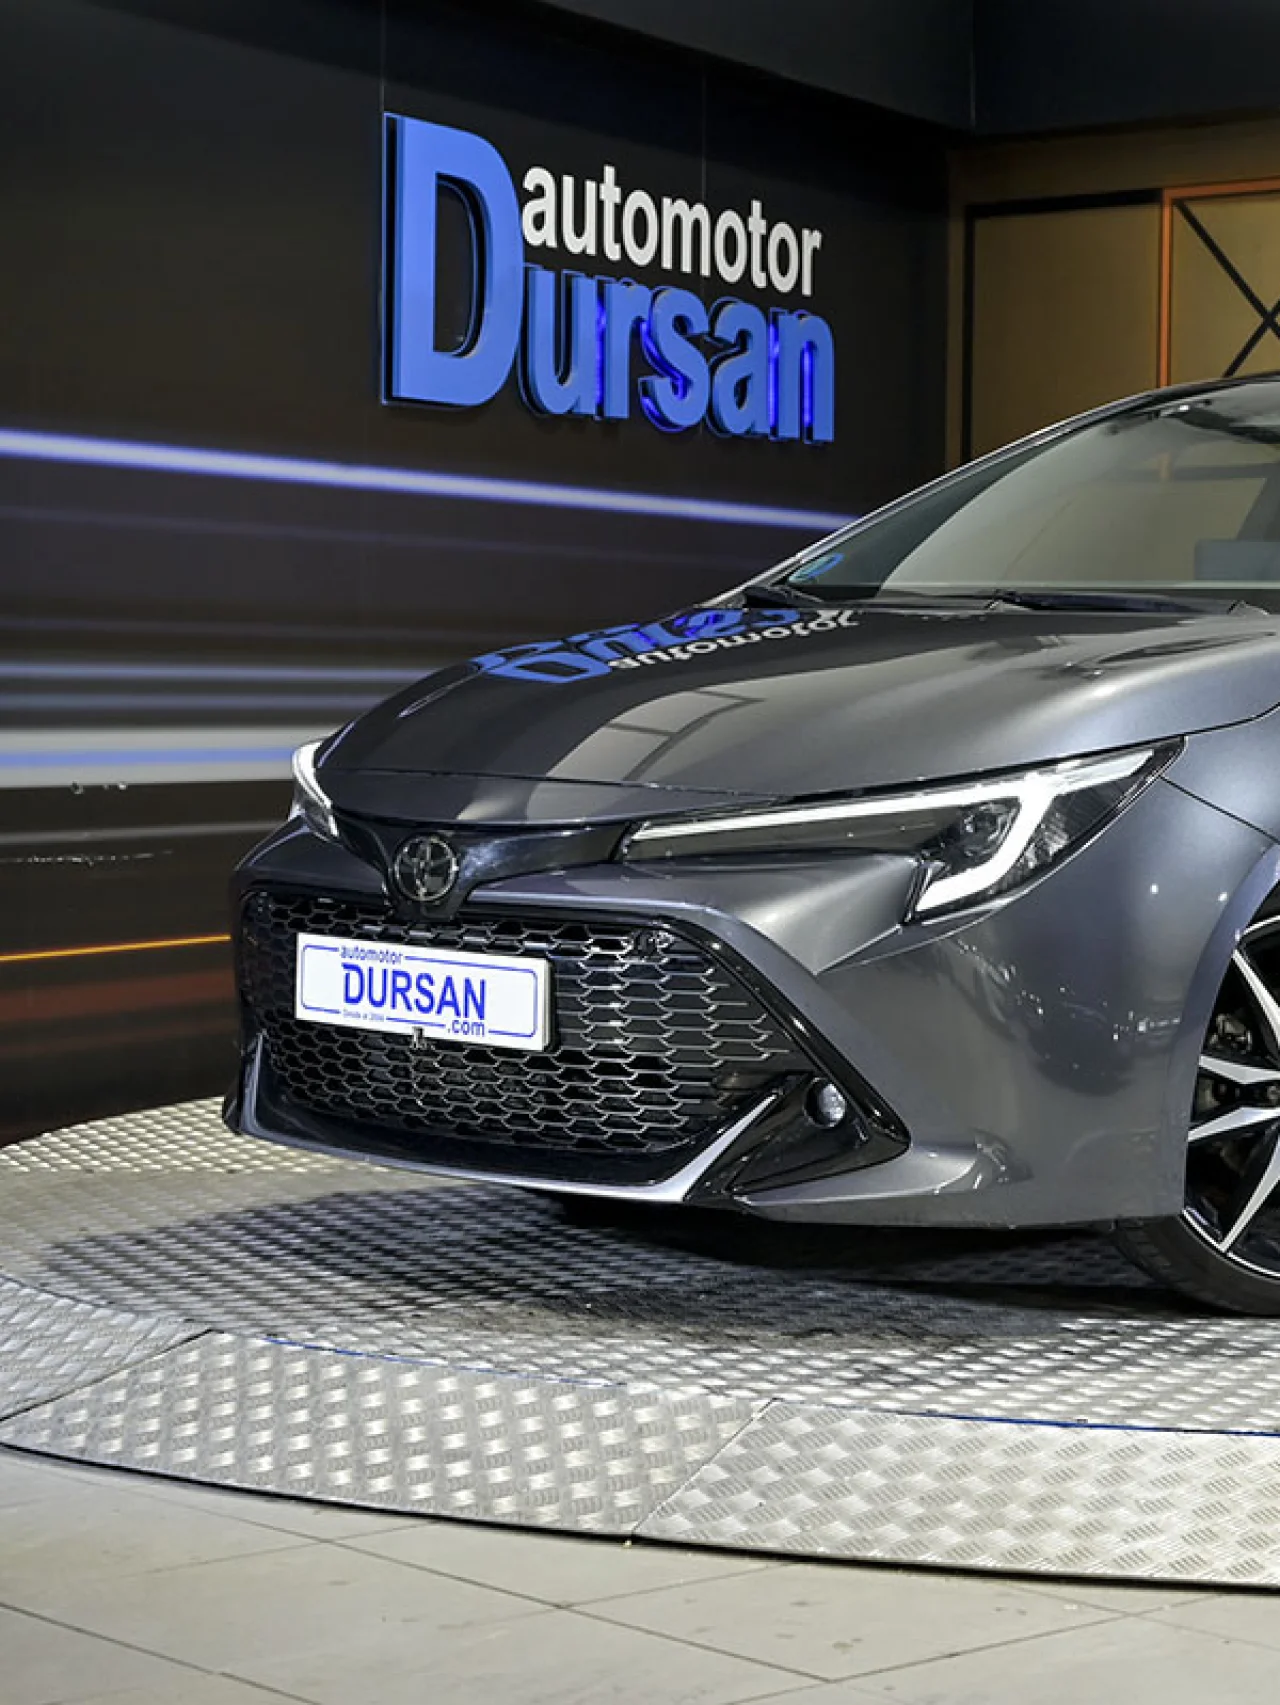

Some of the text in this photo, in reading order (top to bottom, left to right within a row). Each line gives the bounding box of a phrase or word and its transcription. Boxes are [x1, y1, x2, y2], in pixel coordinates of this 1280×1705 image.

[383, 111, 835, 443] Dursan
[521, 165, 822, 297] automotor
[341, 962, 486, 1021] DURSAN
[447, 1018, 486, 1037] .com
